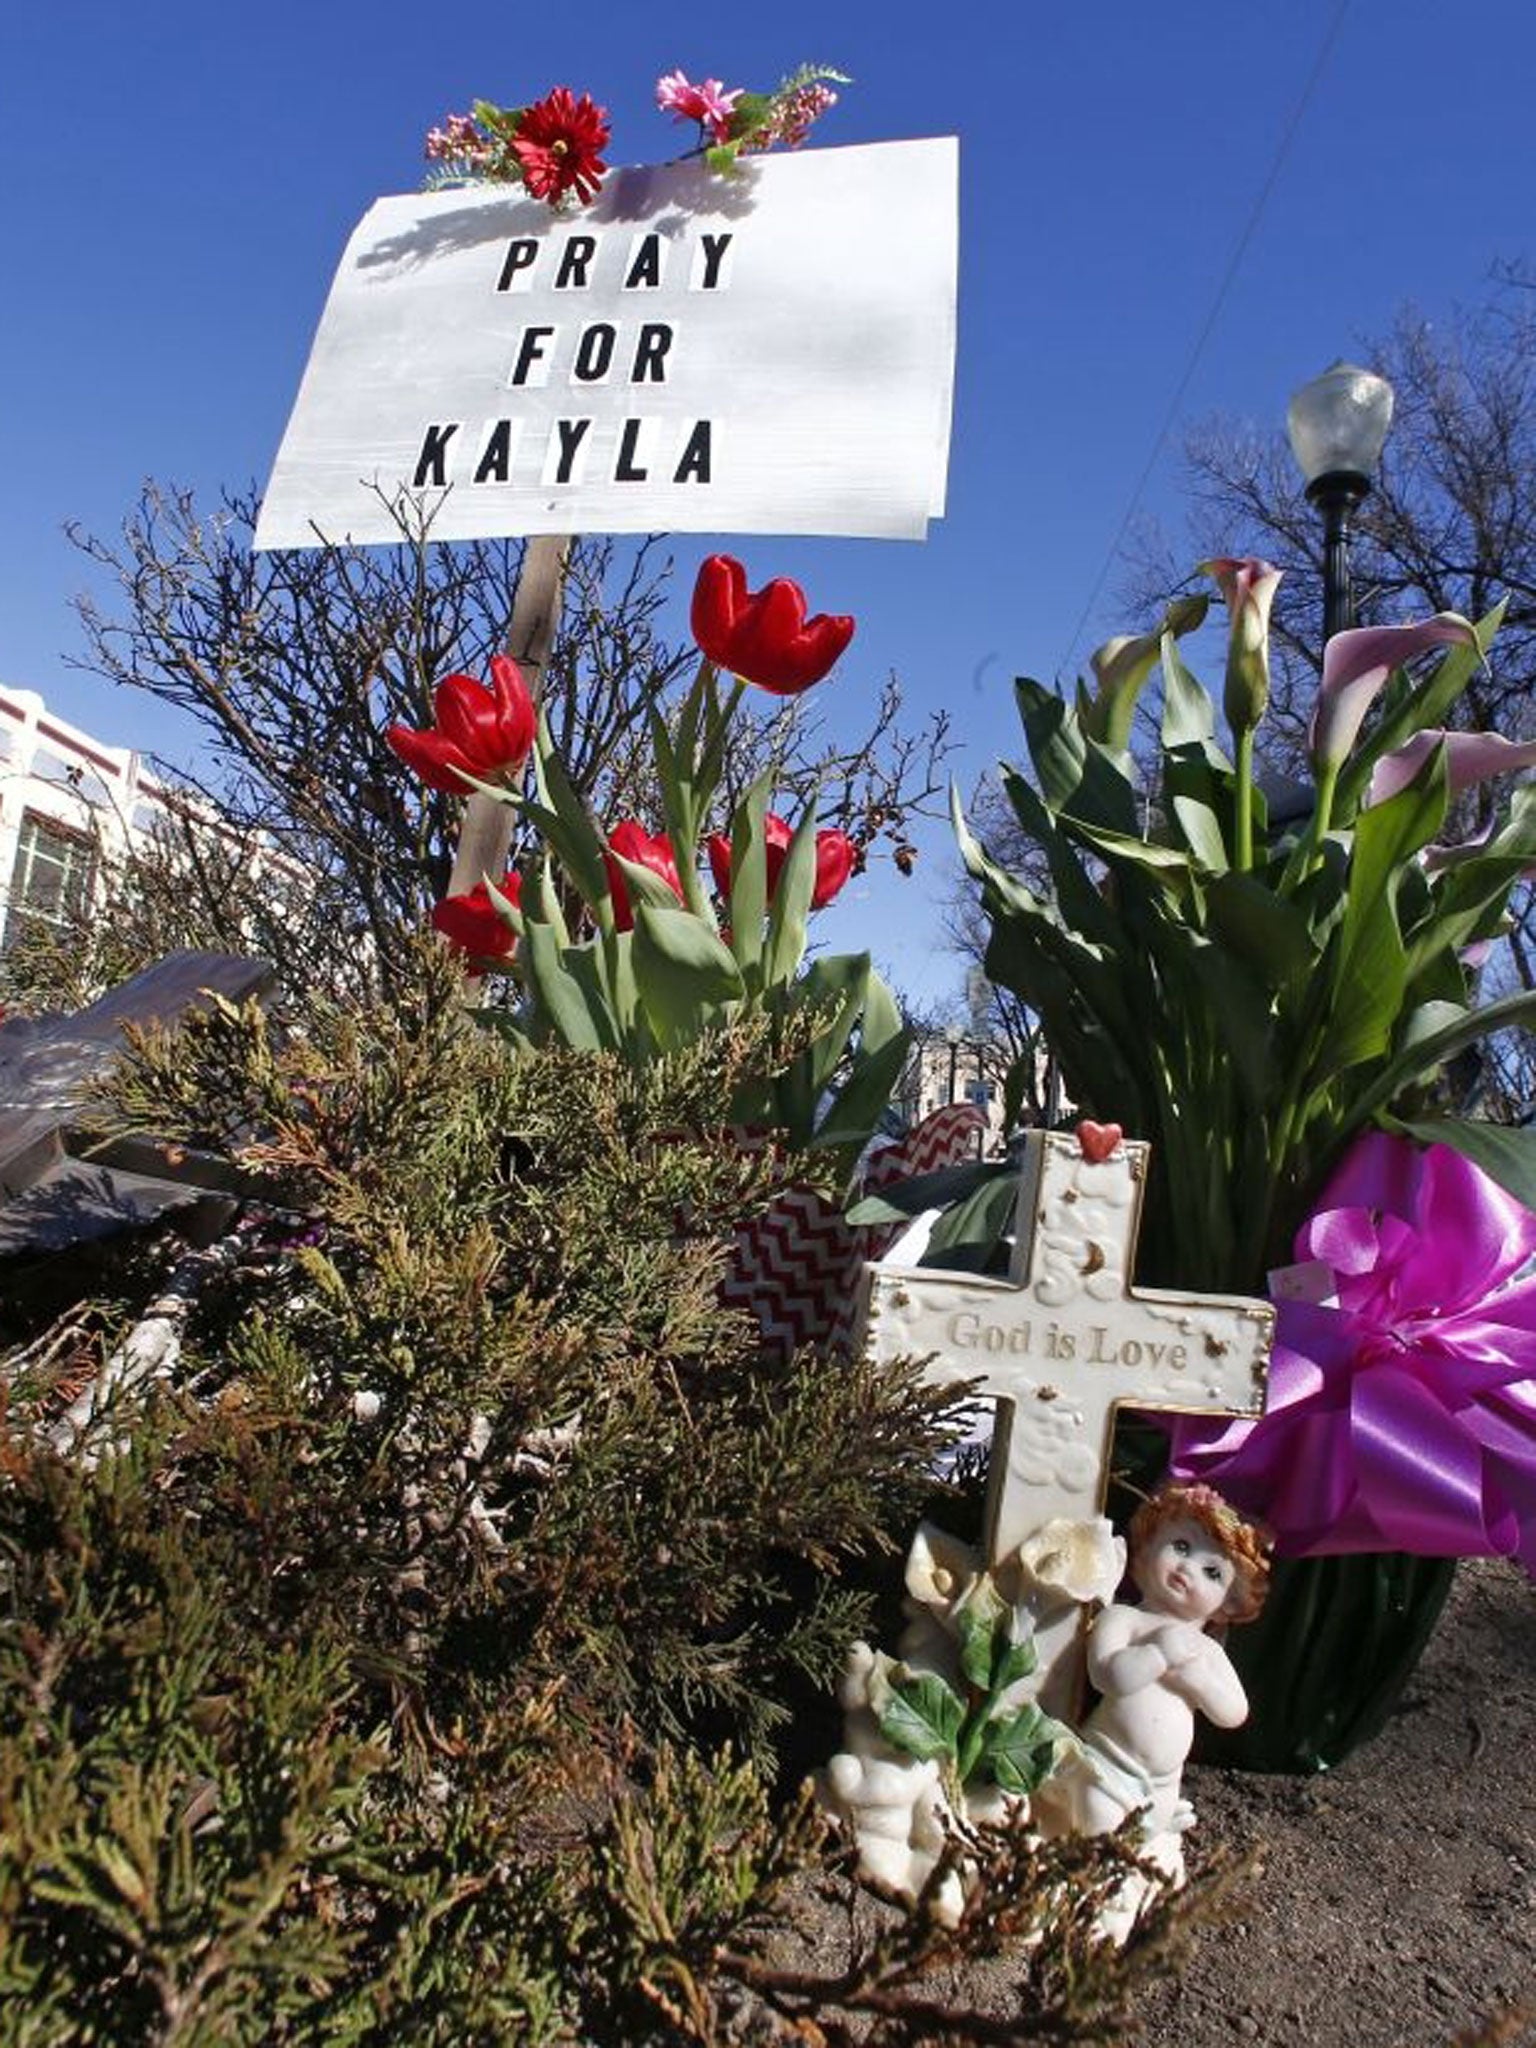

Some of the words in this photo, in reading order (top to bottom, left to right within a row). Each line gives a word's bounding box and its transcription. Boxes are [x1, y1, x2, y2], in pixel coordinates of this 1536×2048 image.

[497, 233, 733, 291] PRAY
[511, 322, 674, 386] FOR
[412, 418, 712, 488] KAYLA
[946, 1311, 1031, 1354] God
[1046, 1321, 1077, 1360] is
[1086, 1327, 1188, 1371] Love
